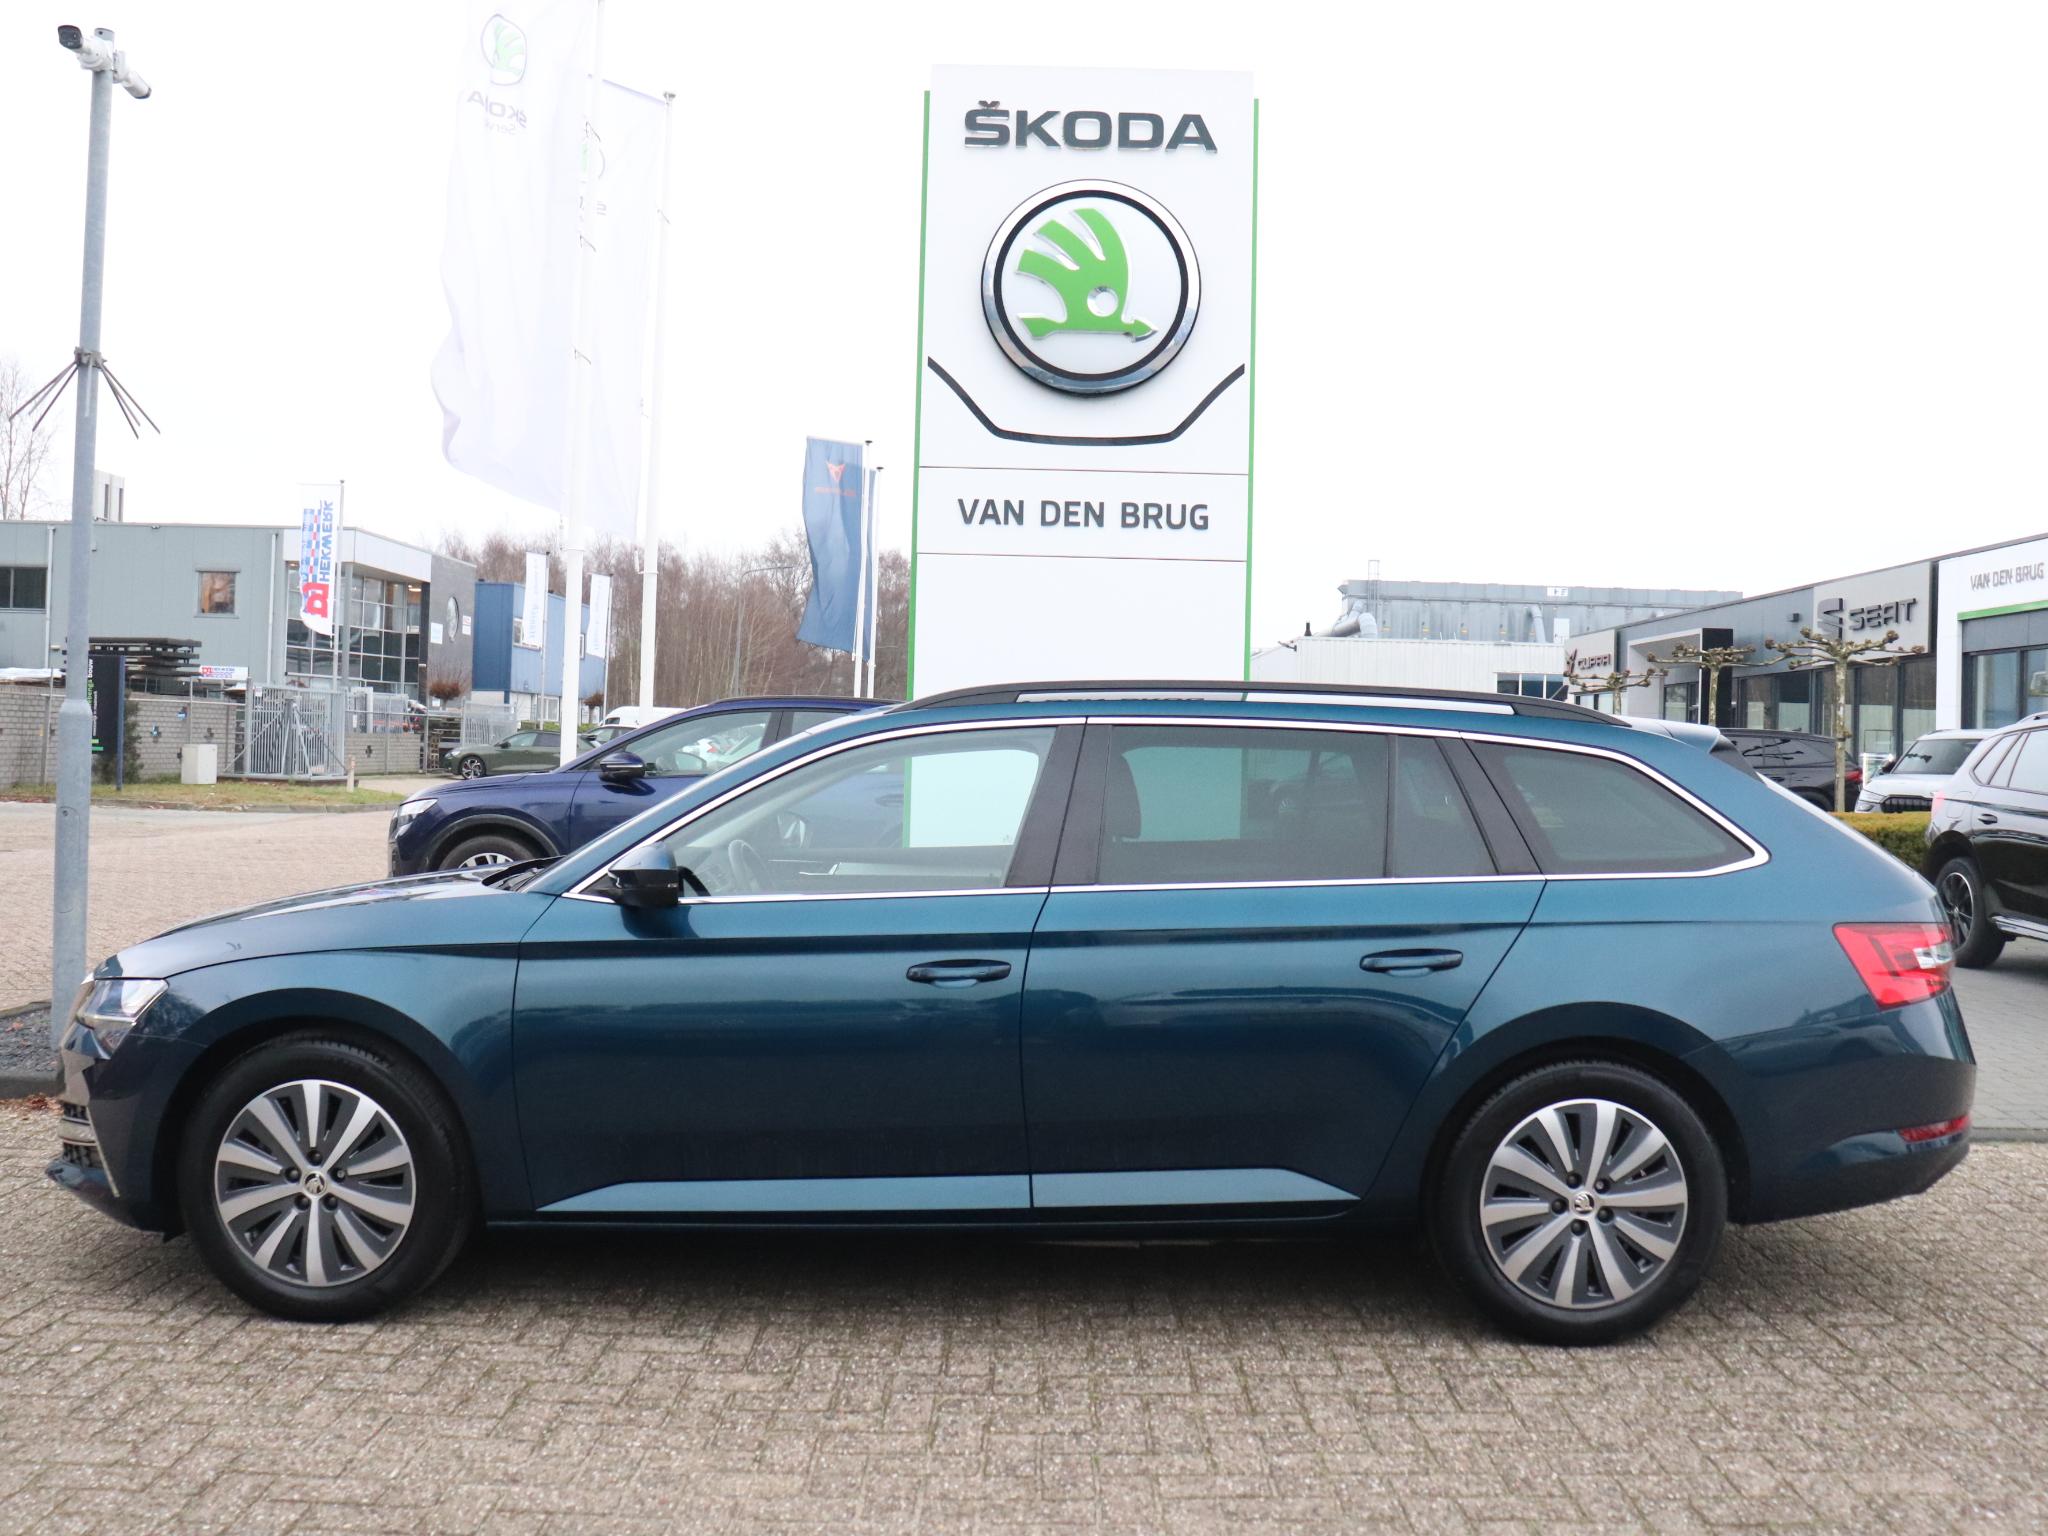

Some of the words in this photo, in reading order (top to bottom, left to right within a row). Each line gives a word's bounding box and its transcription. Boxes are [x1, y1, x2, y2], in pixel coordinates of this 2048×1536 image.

[964, 99, 1218, 153] ŠKODA
[957, 498, 1025, 527] VAN
[1040, 500, 1105, 528] DEN
[1120, 502, 1209, 531] BRUG
[1970, 571, 1991, 592] VAN
[1992, 568, 2013, 588] DEN
[2015, 562, 2045, 583] BRUG
[1849, 598, 1918, 631] SEAT
